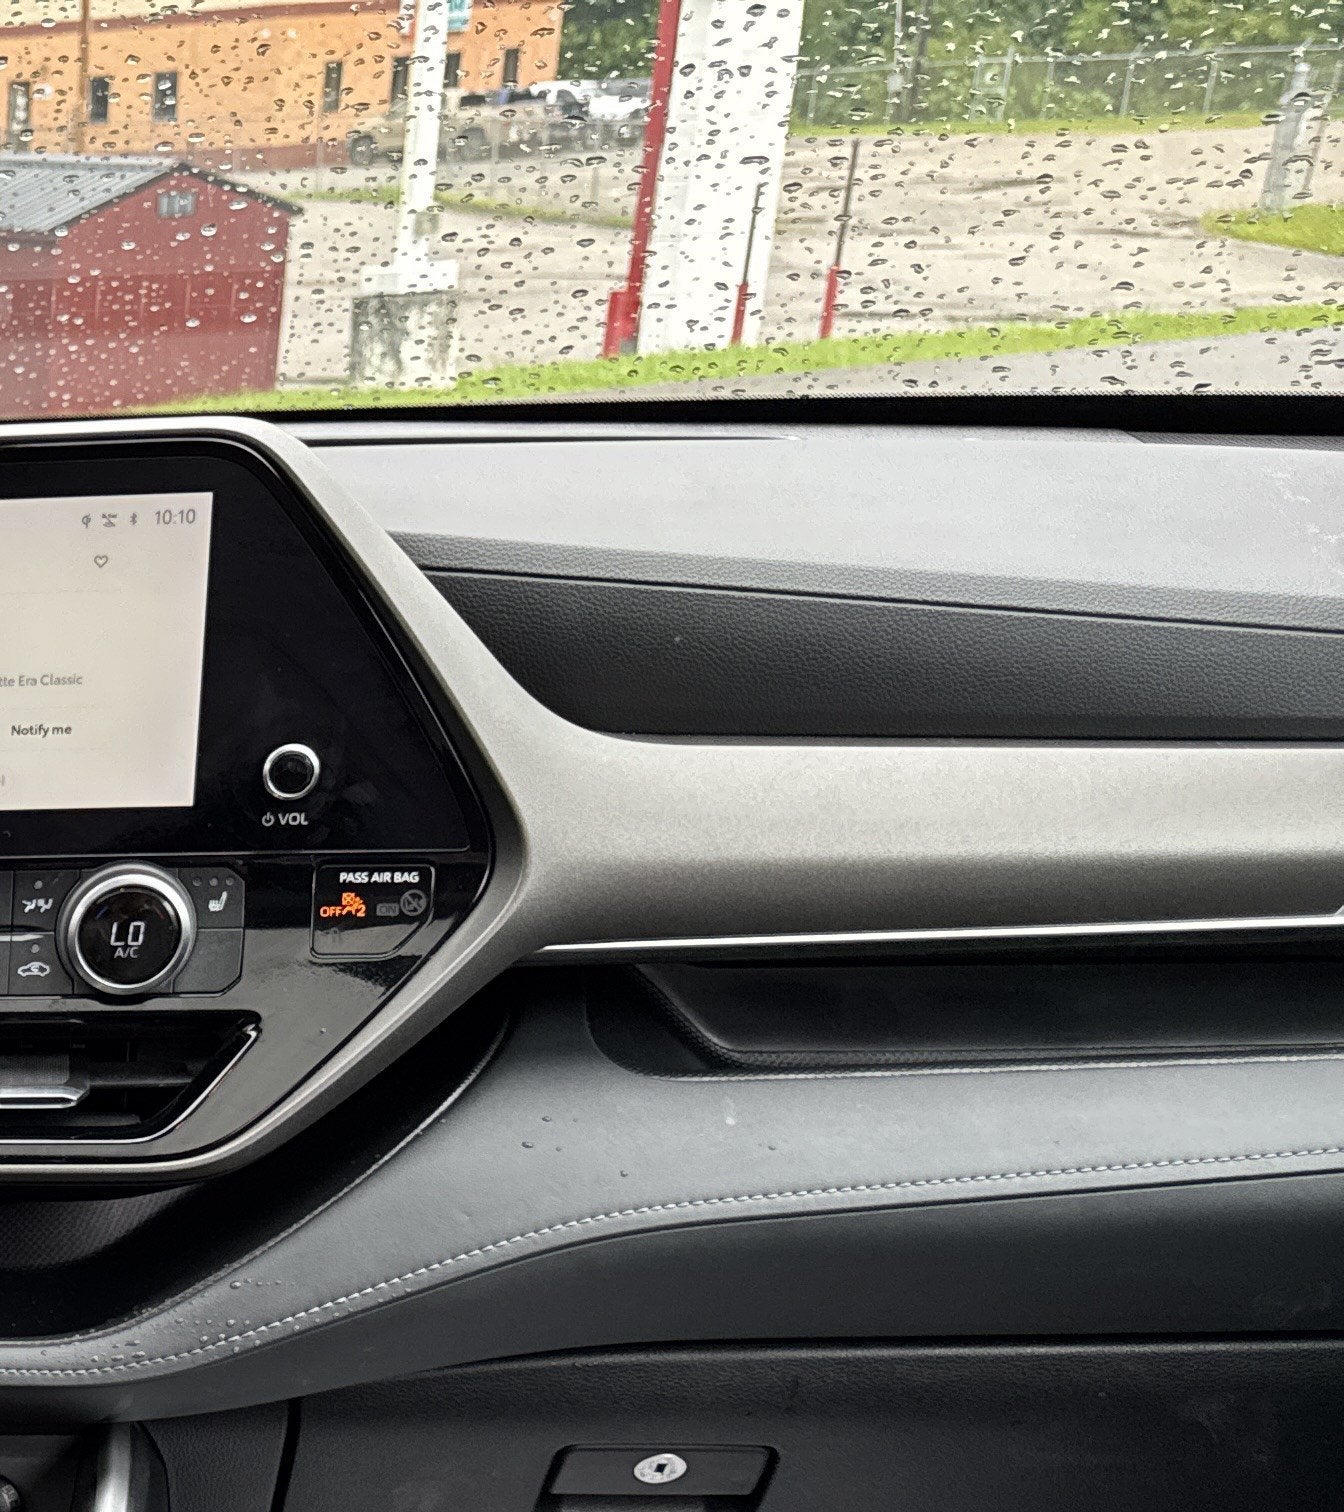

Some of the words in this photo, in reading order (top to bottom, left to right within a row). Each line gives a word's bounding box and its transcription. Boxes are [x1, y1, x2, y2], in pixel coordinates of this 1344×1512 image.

[155, 508, 196, 525] 10:10
[19, 675, 37, 686] Era
[40, 673, 83, 686] Classic
[11, 723, 49, 738] Notify
[52, 725, 72, 735] me
[278, 812, 309, 826] VOL
[339, 872, 369, 883] PASS
[370, 872, 392, 883] AIR
[393, 872, 419, 883] BAG
[320, 906, 342, 917] OFF
[110, 921, 145, 946] LO
[114, 947, 138, 959] A/C
